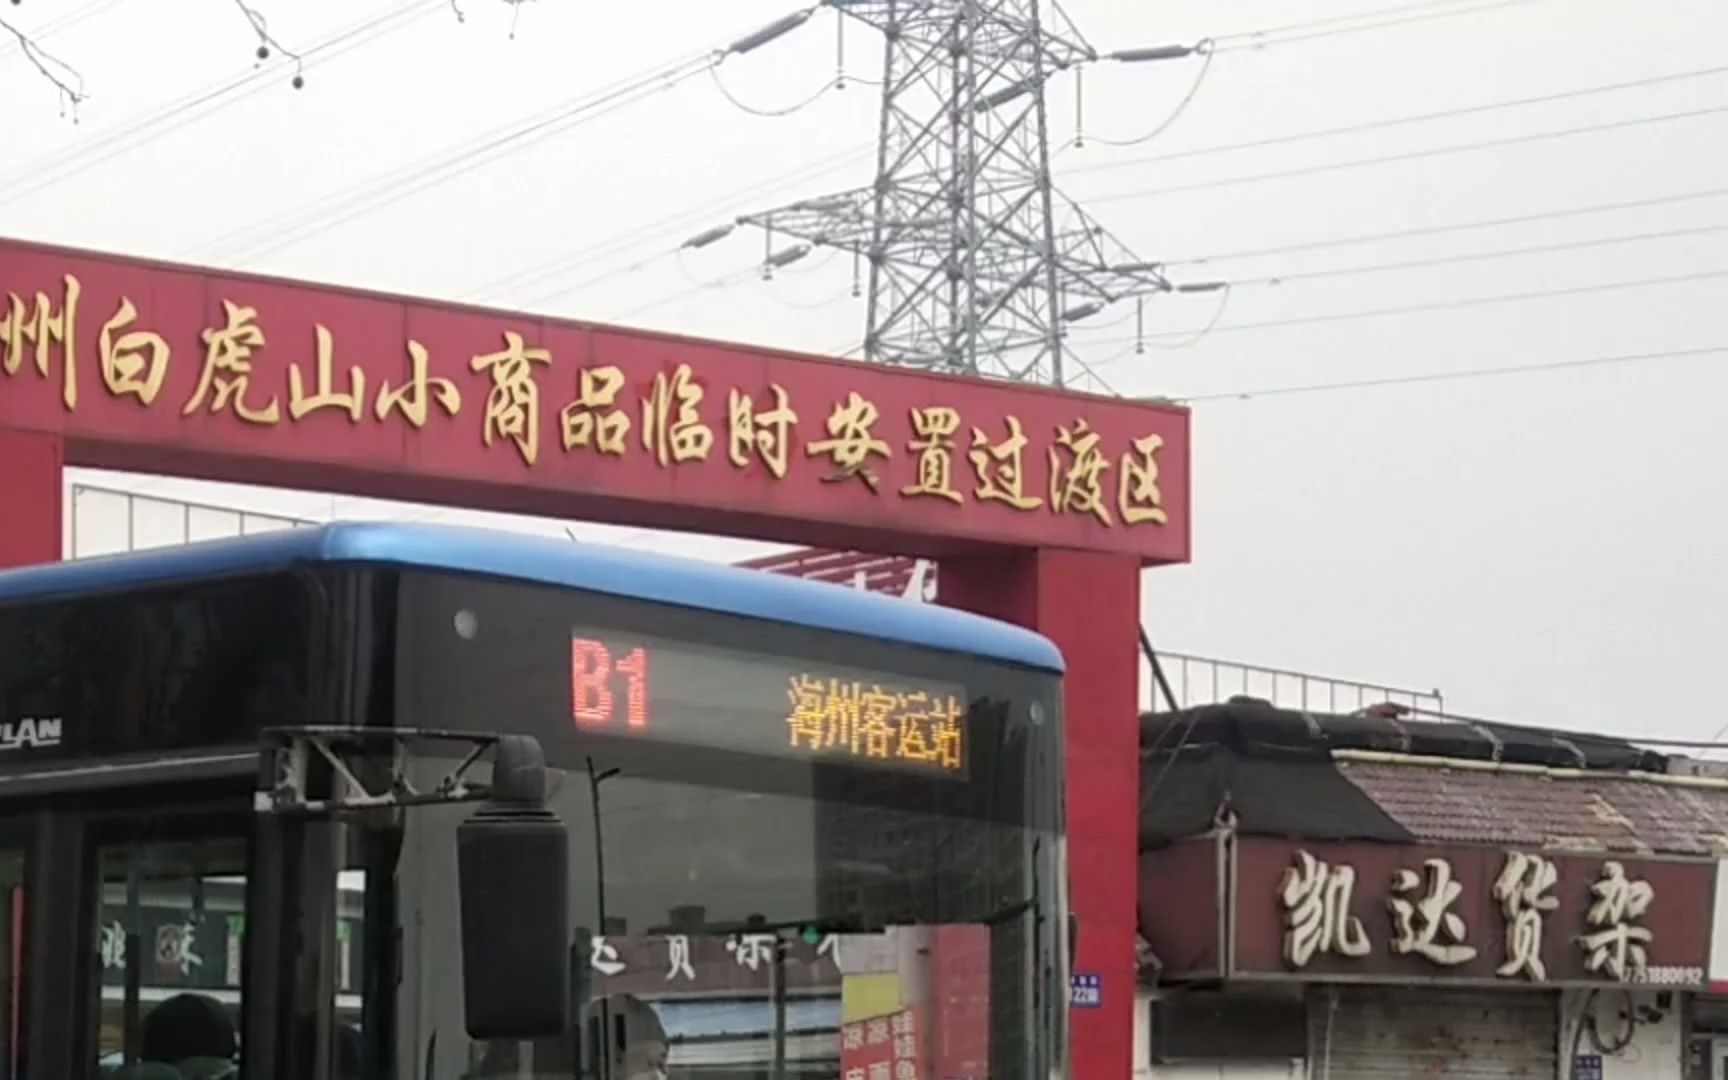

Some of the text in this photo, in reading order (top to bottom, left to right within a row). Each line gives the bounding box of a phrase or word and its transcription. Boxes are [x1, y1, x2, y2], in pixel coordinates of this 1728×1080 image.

[572, 637, 648, 729] B1
[786, 672, 963, 769] 海州客运站
[1282, 849, 1656, 982] 凯达货架
